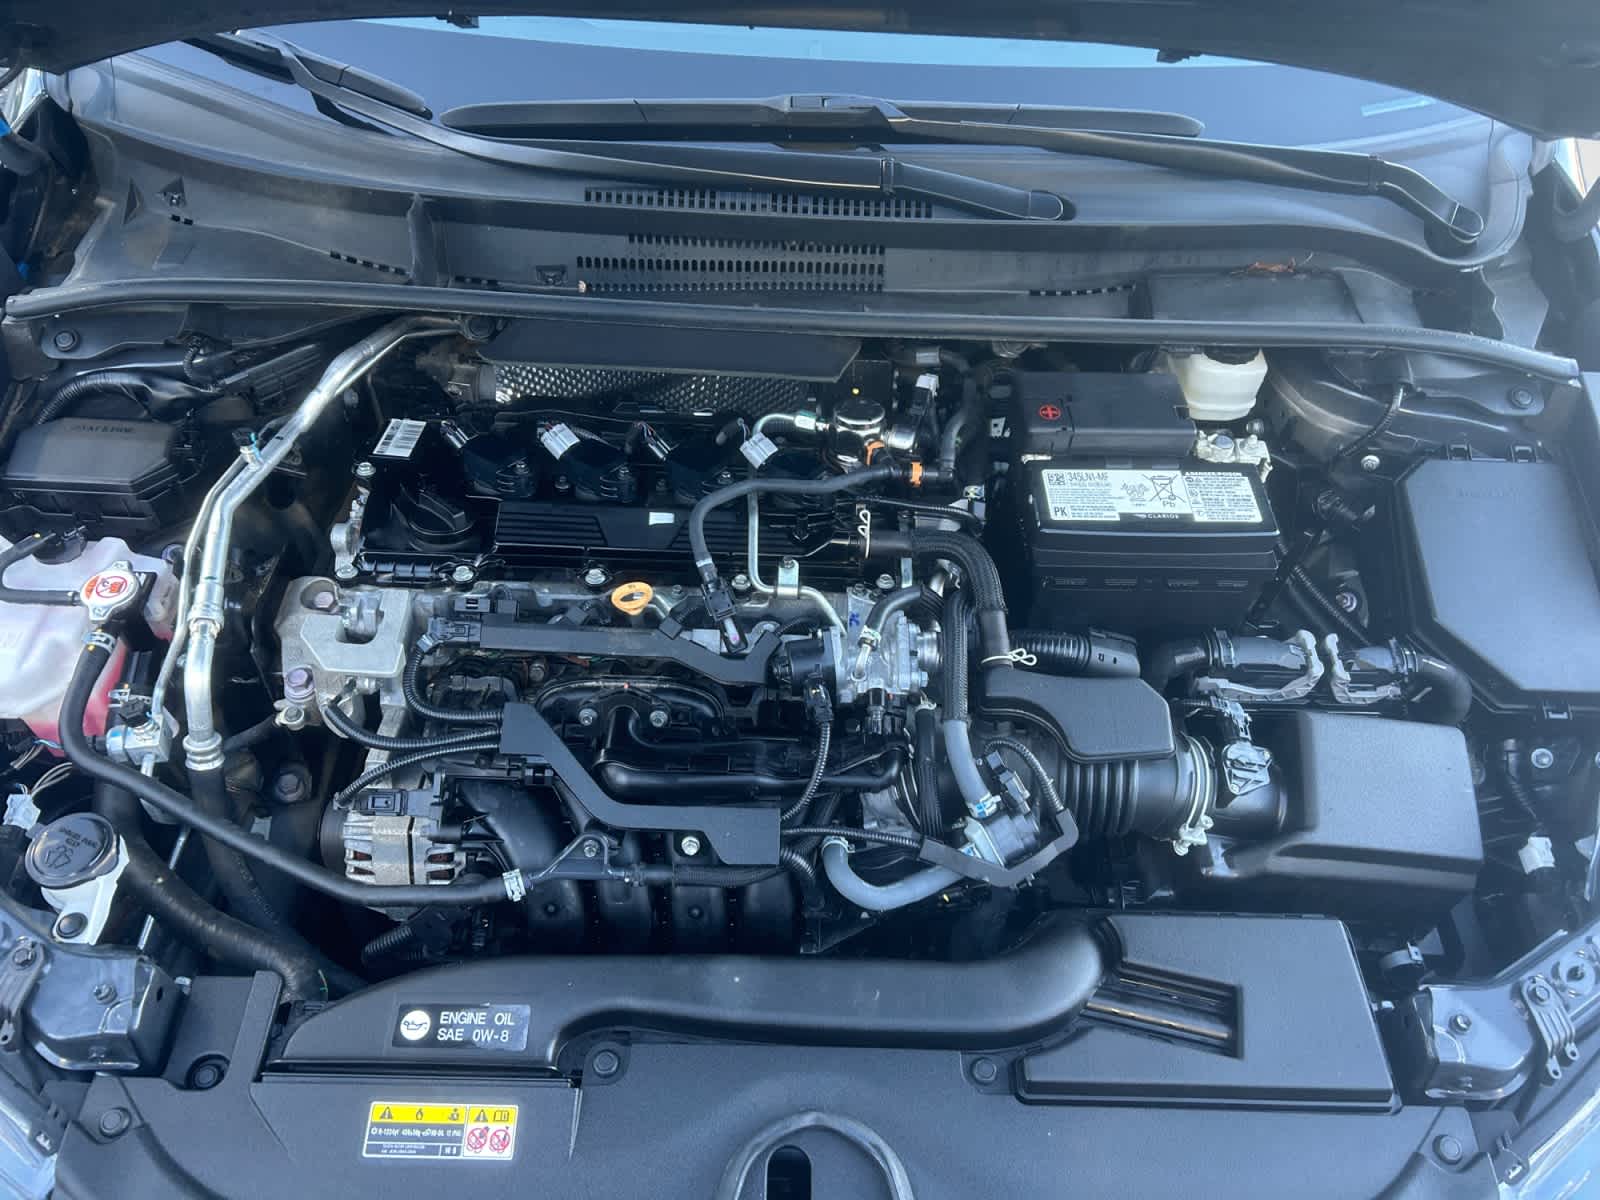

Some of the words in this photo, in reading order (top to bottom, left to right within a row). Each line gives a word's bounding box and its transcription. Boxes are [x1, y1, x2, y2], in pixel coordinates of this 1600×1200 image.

[1054, 506, 1068, 516] PK
[440, 1011, 488, 1025] ENGINE
[494, 1013, 515, 1026] OIL
[437, 1028, 465, 1041] SAE
[472, 1029, 510, 1042] 0W-8
